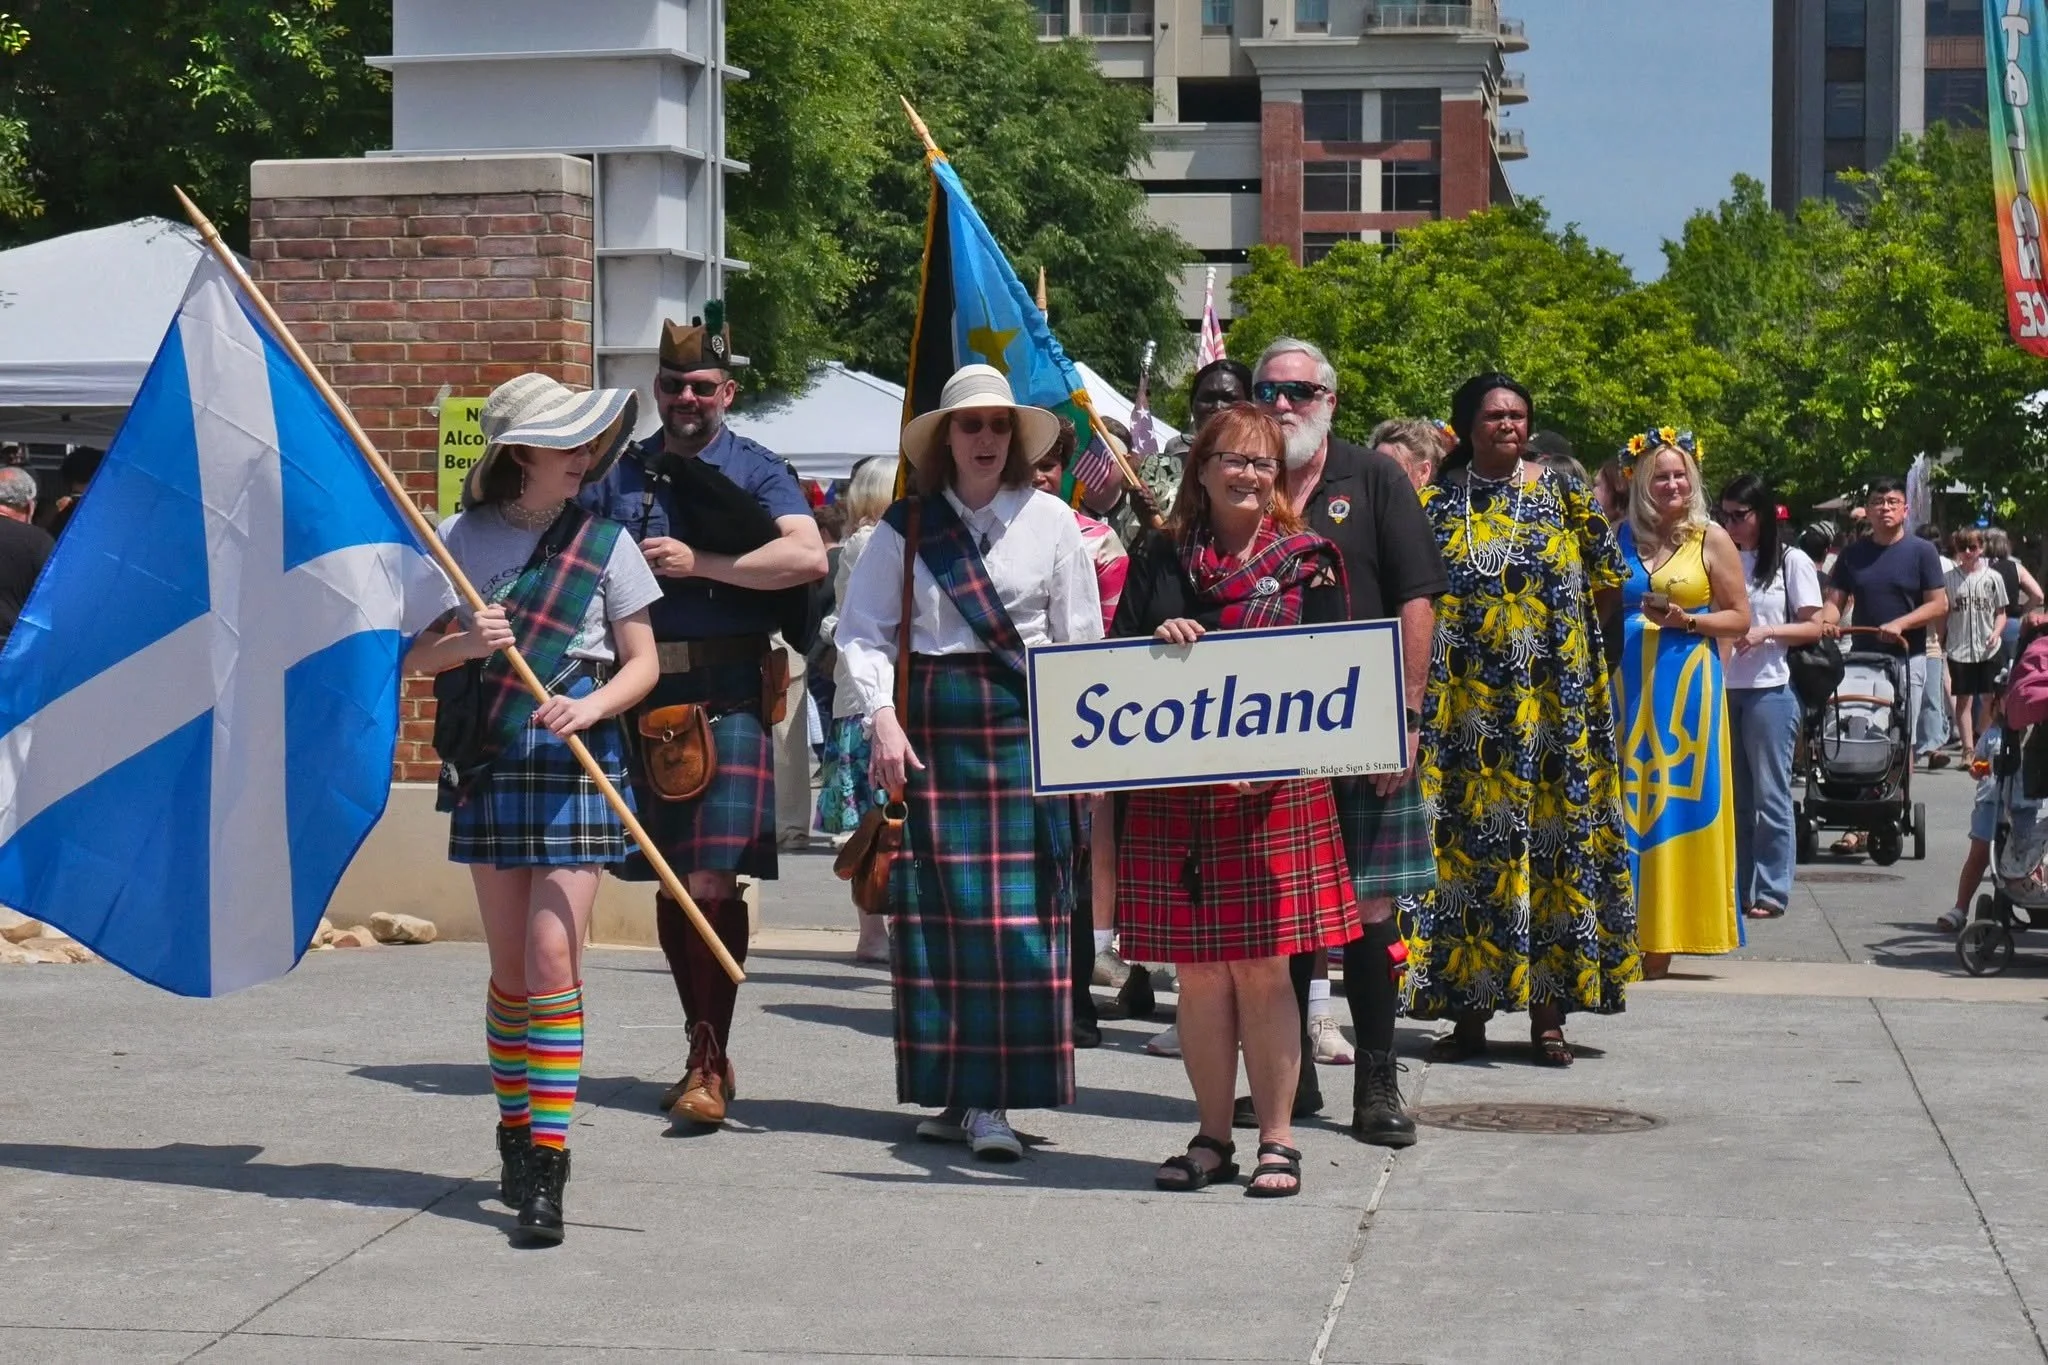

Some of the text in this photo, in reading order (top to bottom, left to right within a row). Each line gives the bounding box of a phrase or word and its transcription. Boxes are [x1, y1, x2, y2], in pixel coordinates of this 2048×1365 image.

[444, 430, 488, 446] Alco
[1071, 666, 1361, 748] Scotland
[1300, 767, 1318, 776] Blue
[1320, 764, 1343, 775] Ridge
[1345, 763, 1363, 774] Sign
[1373, 761, 1399, 771] Stamp
